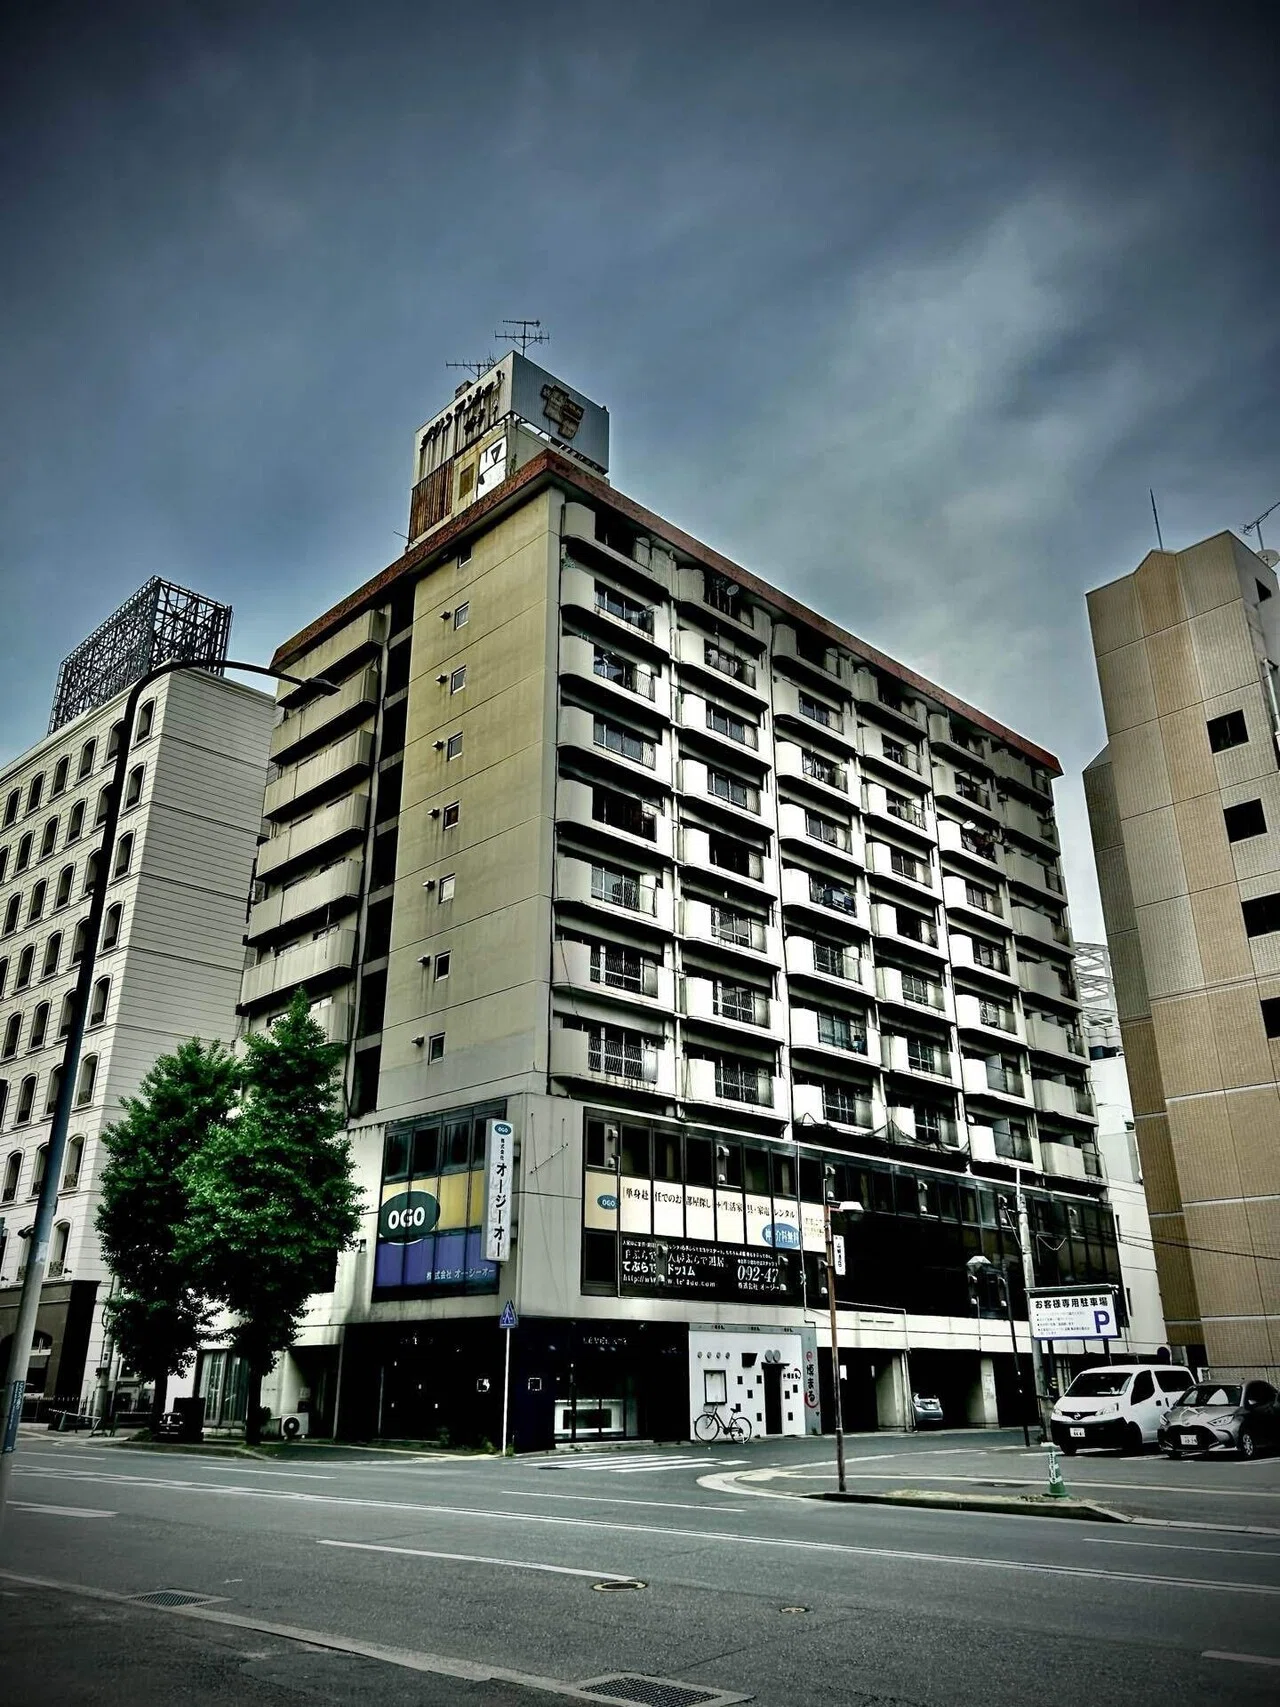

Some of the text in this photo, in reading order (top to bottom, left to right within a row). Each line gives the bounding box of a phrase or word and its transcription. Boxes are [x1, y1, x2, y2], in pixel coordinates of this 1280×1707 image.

[493, 1162, 507, 1257] オージーオー
[602, 1199, 615, 1207] OGO
[388, 1206, 426, 1230] OGO
[426, 1267, 495, 1281] 株式会社 オージーオー
[1035, 1297, 1108, 1309] お客様専用駐車場
[1093, 1310, 1110, 1334] P
